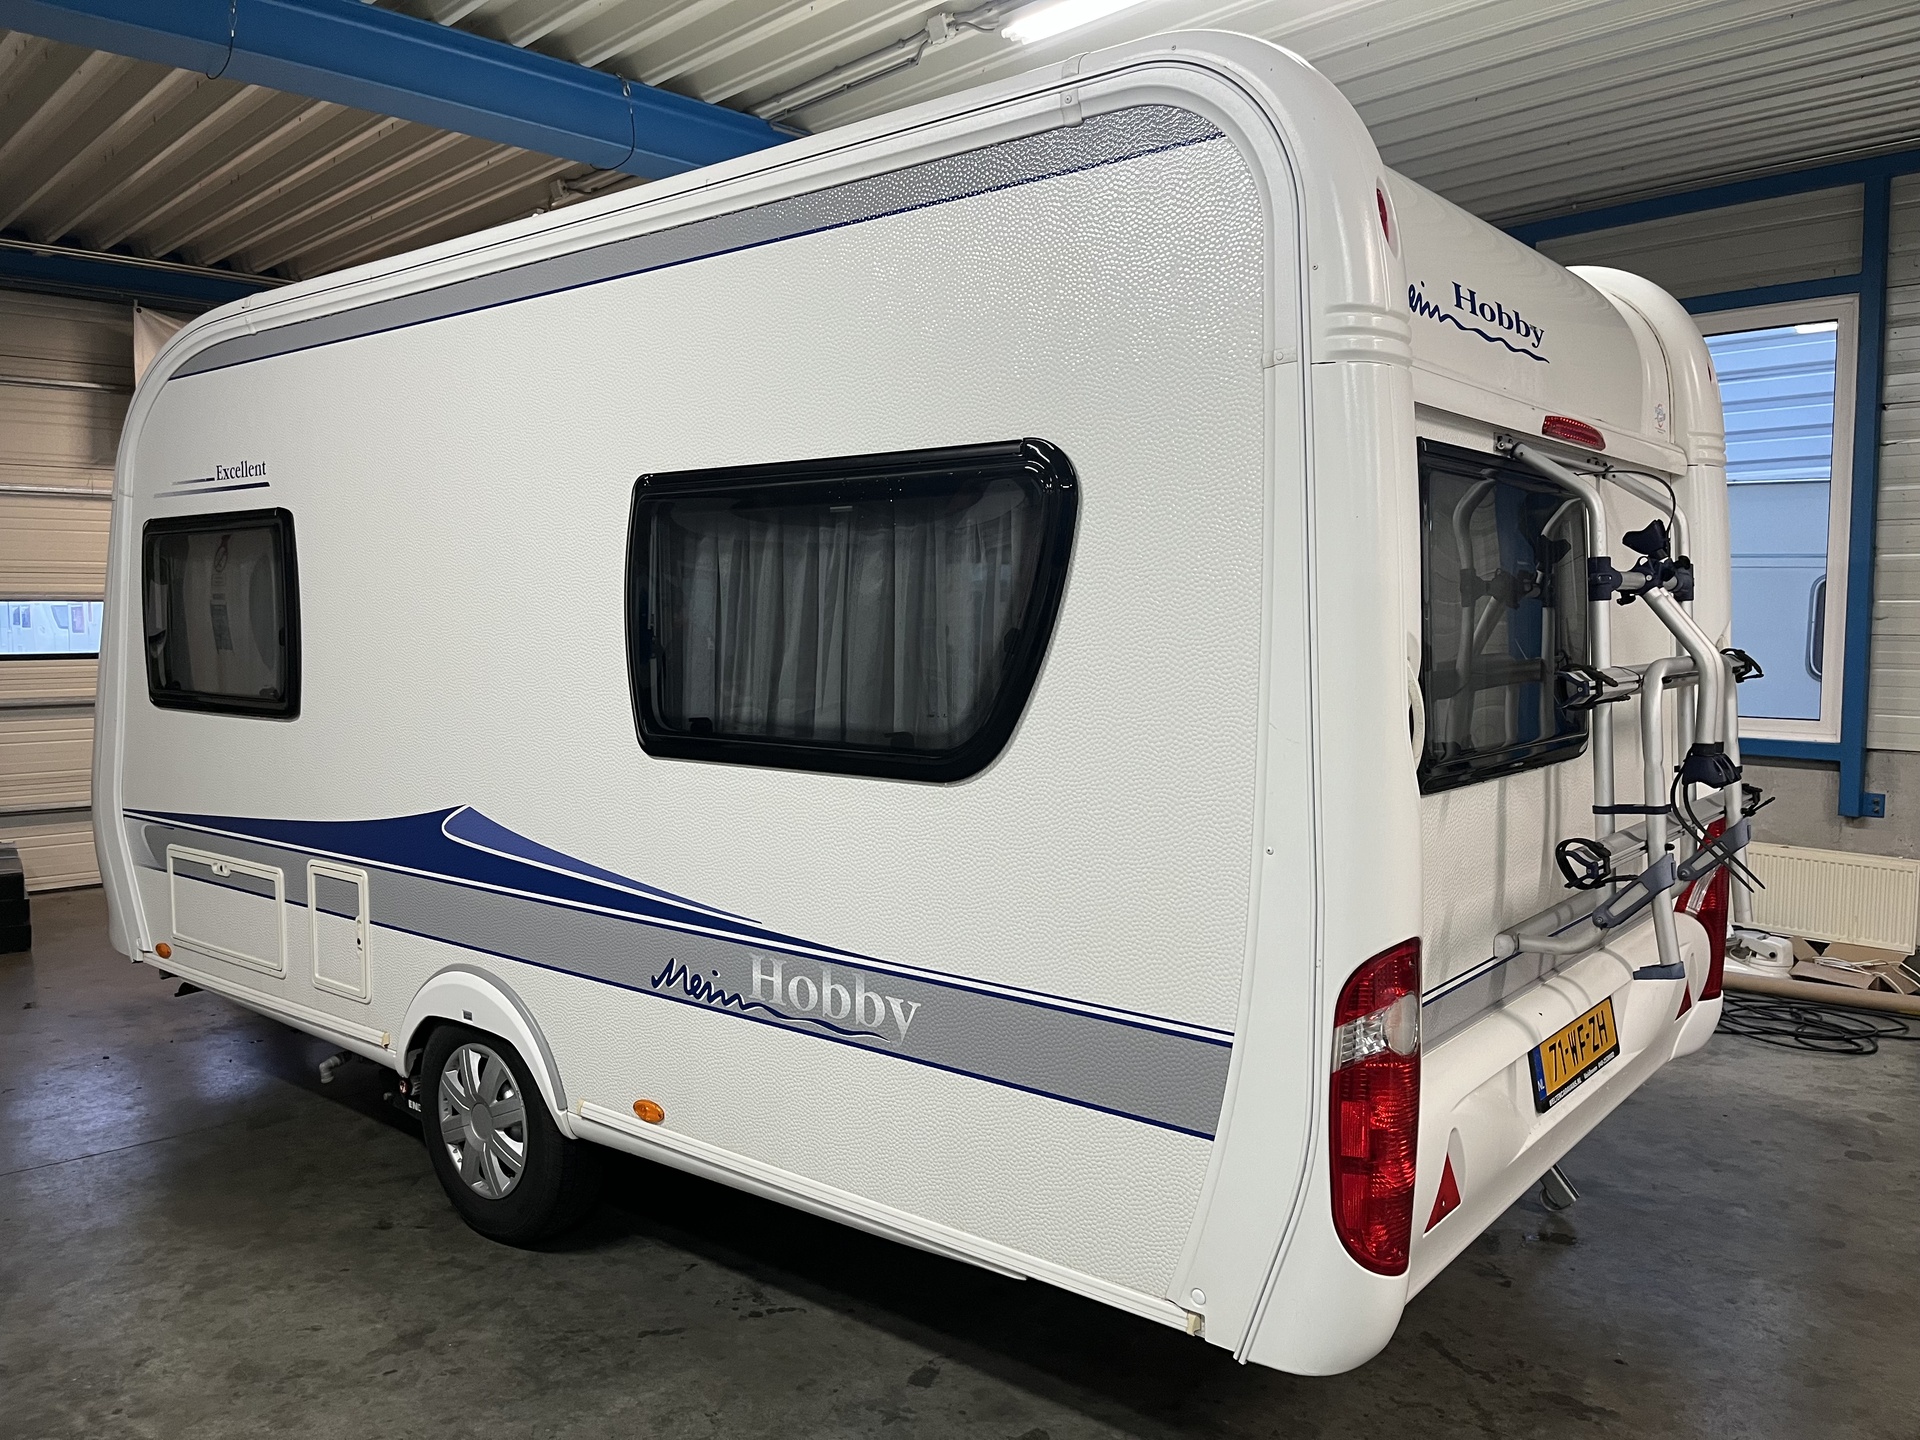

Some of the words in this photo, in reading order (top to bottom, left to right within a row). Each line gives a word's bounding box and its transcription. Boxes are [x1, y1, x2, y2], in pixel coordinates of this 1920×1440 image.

[1408, 280, 1450, 323] ein
[1451, 281, 1545, 348] Hobby
[216, 460, 267, 481] Excellent
[650, 957, 757, 1012] Mein
[749, 952, 922, 1043] Hobby
[1548, 1009, 1608, 1082] 71-WF-ZH
[1537, 1078, 1546, 1092] NL
